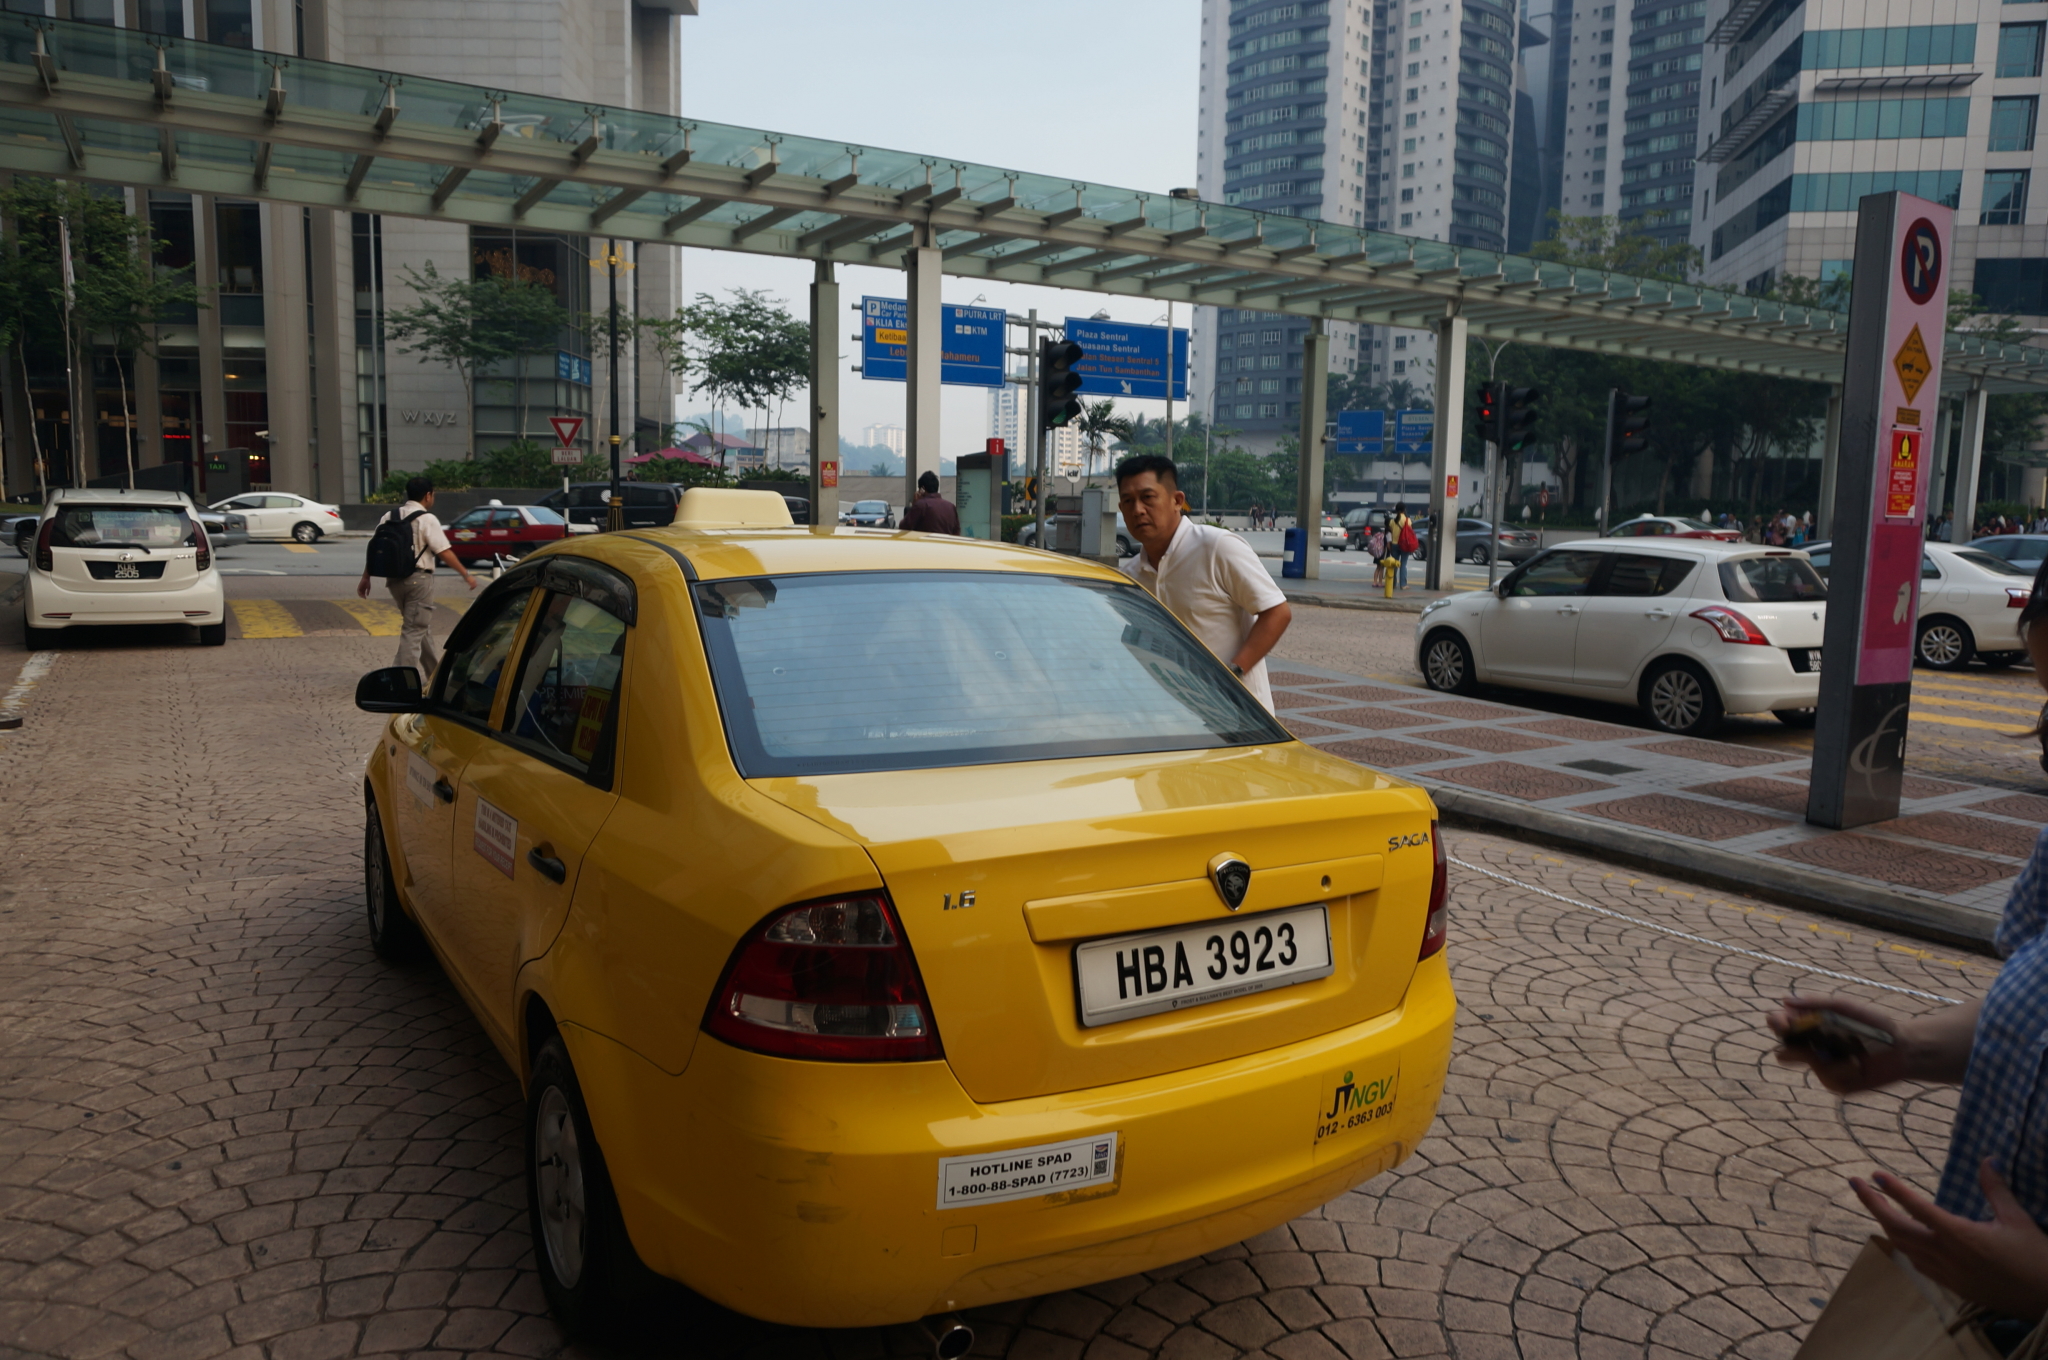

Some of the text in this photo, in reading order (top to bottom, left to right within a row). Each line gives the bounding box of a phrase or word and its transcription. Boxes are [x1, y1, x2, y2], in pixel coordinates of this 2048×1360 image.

[1913, 235, 1934, 288] P
[871, 303, 876, 312] P
[881, 301, 906, 311] Medan
[893, 311, 907, 319] Park
[964, 310, 1002, 320] PUTRA LRT
[876, 318, 893, 328] KLIA
[972, 326, 987, 335] KTM
[1077, 330, 1128, 341] Plaza Sentral
[1077, 341, 1140, 353] Suasana Sentral
[1100, 354, 1124, 363] Stesen
[1127, 356, 1152, 364] Sentral
[1099, 365, 1112, 373] Tun
[1115, 367, 1160, 376] Sambanthan
[115, 570, 139, 578] 2505
[1388, 832, 1430, 852] SAGA
[943, 890, 976, 910] 1.6
[1116, 922, 1297, 999] HBA 3923
[1318, 1122, 1338, 1138] 012
[1348, 1109, 1373, 1128] 6363
[1375, 1102, 1393, 1118] 003
[970, 1152, 1072, 1177] HOTLINE SPAD
[948, 1165, 1089, 1196] 1-800-88-SPAD (7723)
